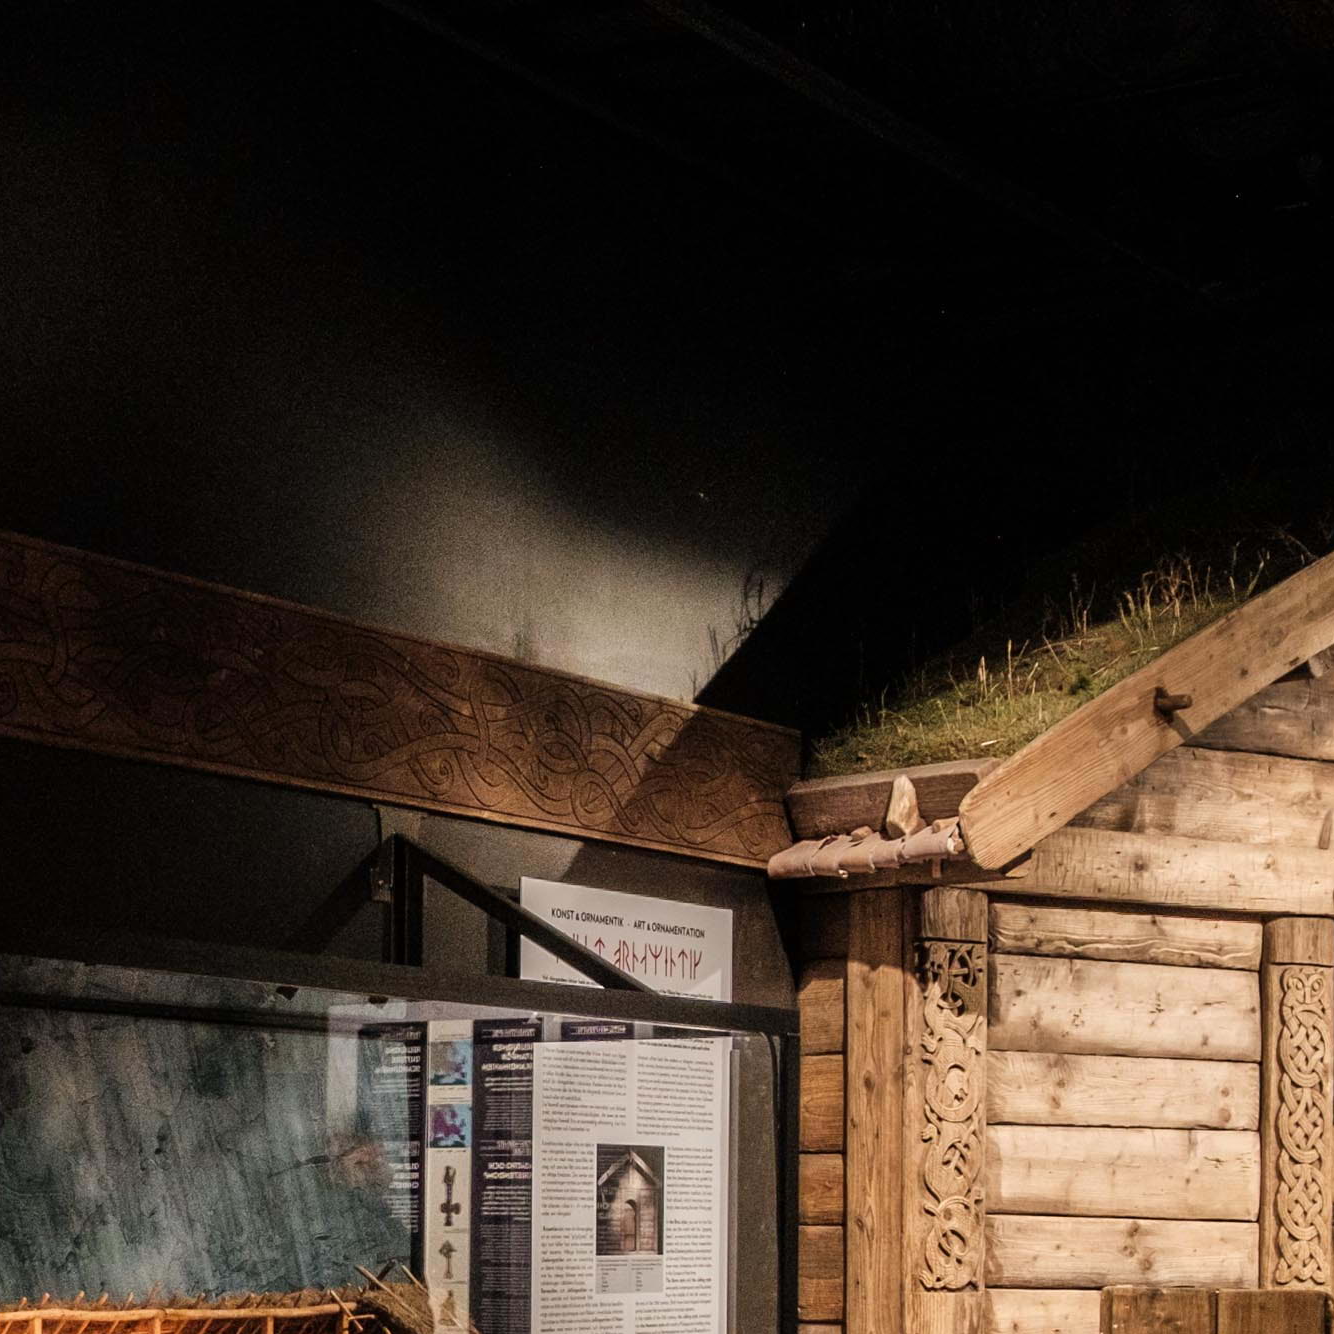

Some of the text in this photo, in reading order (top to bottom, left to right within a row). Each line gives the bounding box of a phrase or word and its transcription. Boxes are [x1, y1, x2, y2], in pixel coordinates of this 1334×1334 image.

[551, 908, 575, 920] KONST
[581, 912, 624, 927] ORNAMENTIK
[634, 920, 646, 930] ART
[652, 922, 705, 938] ORNAMENTATION
